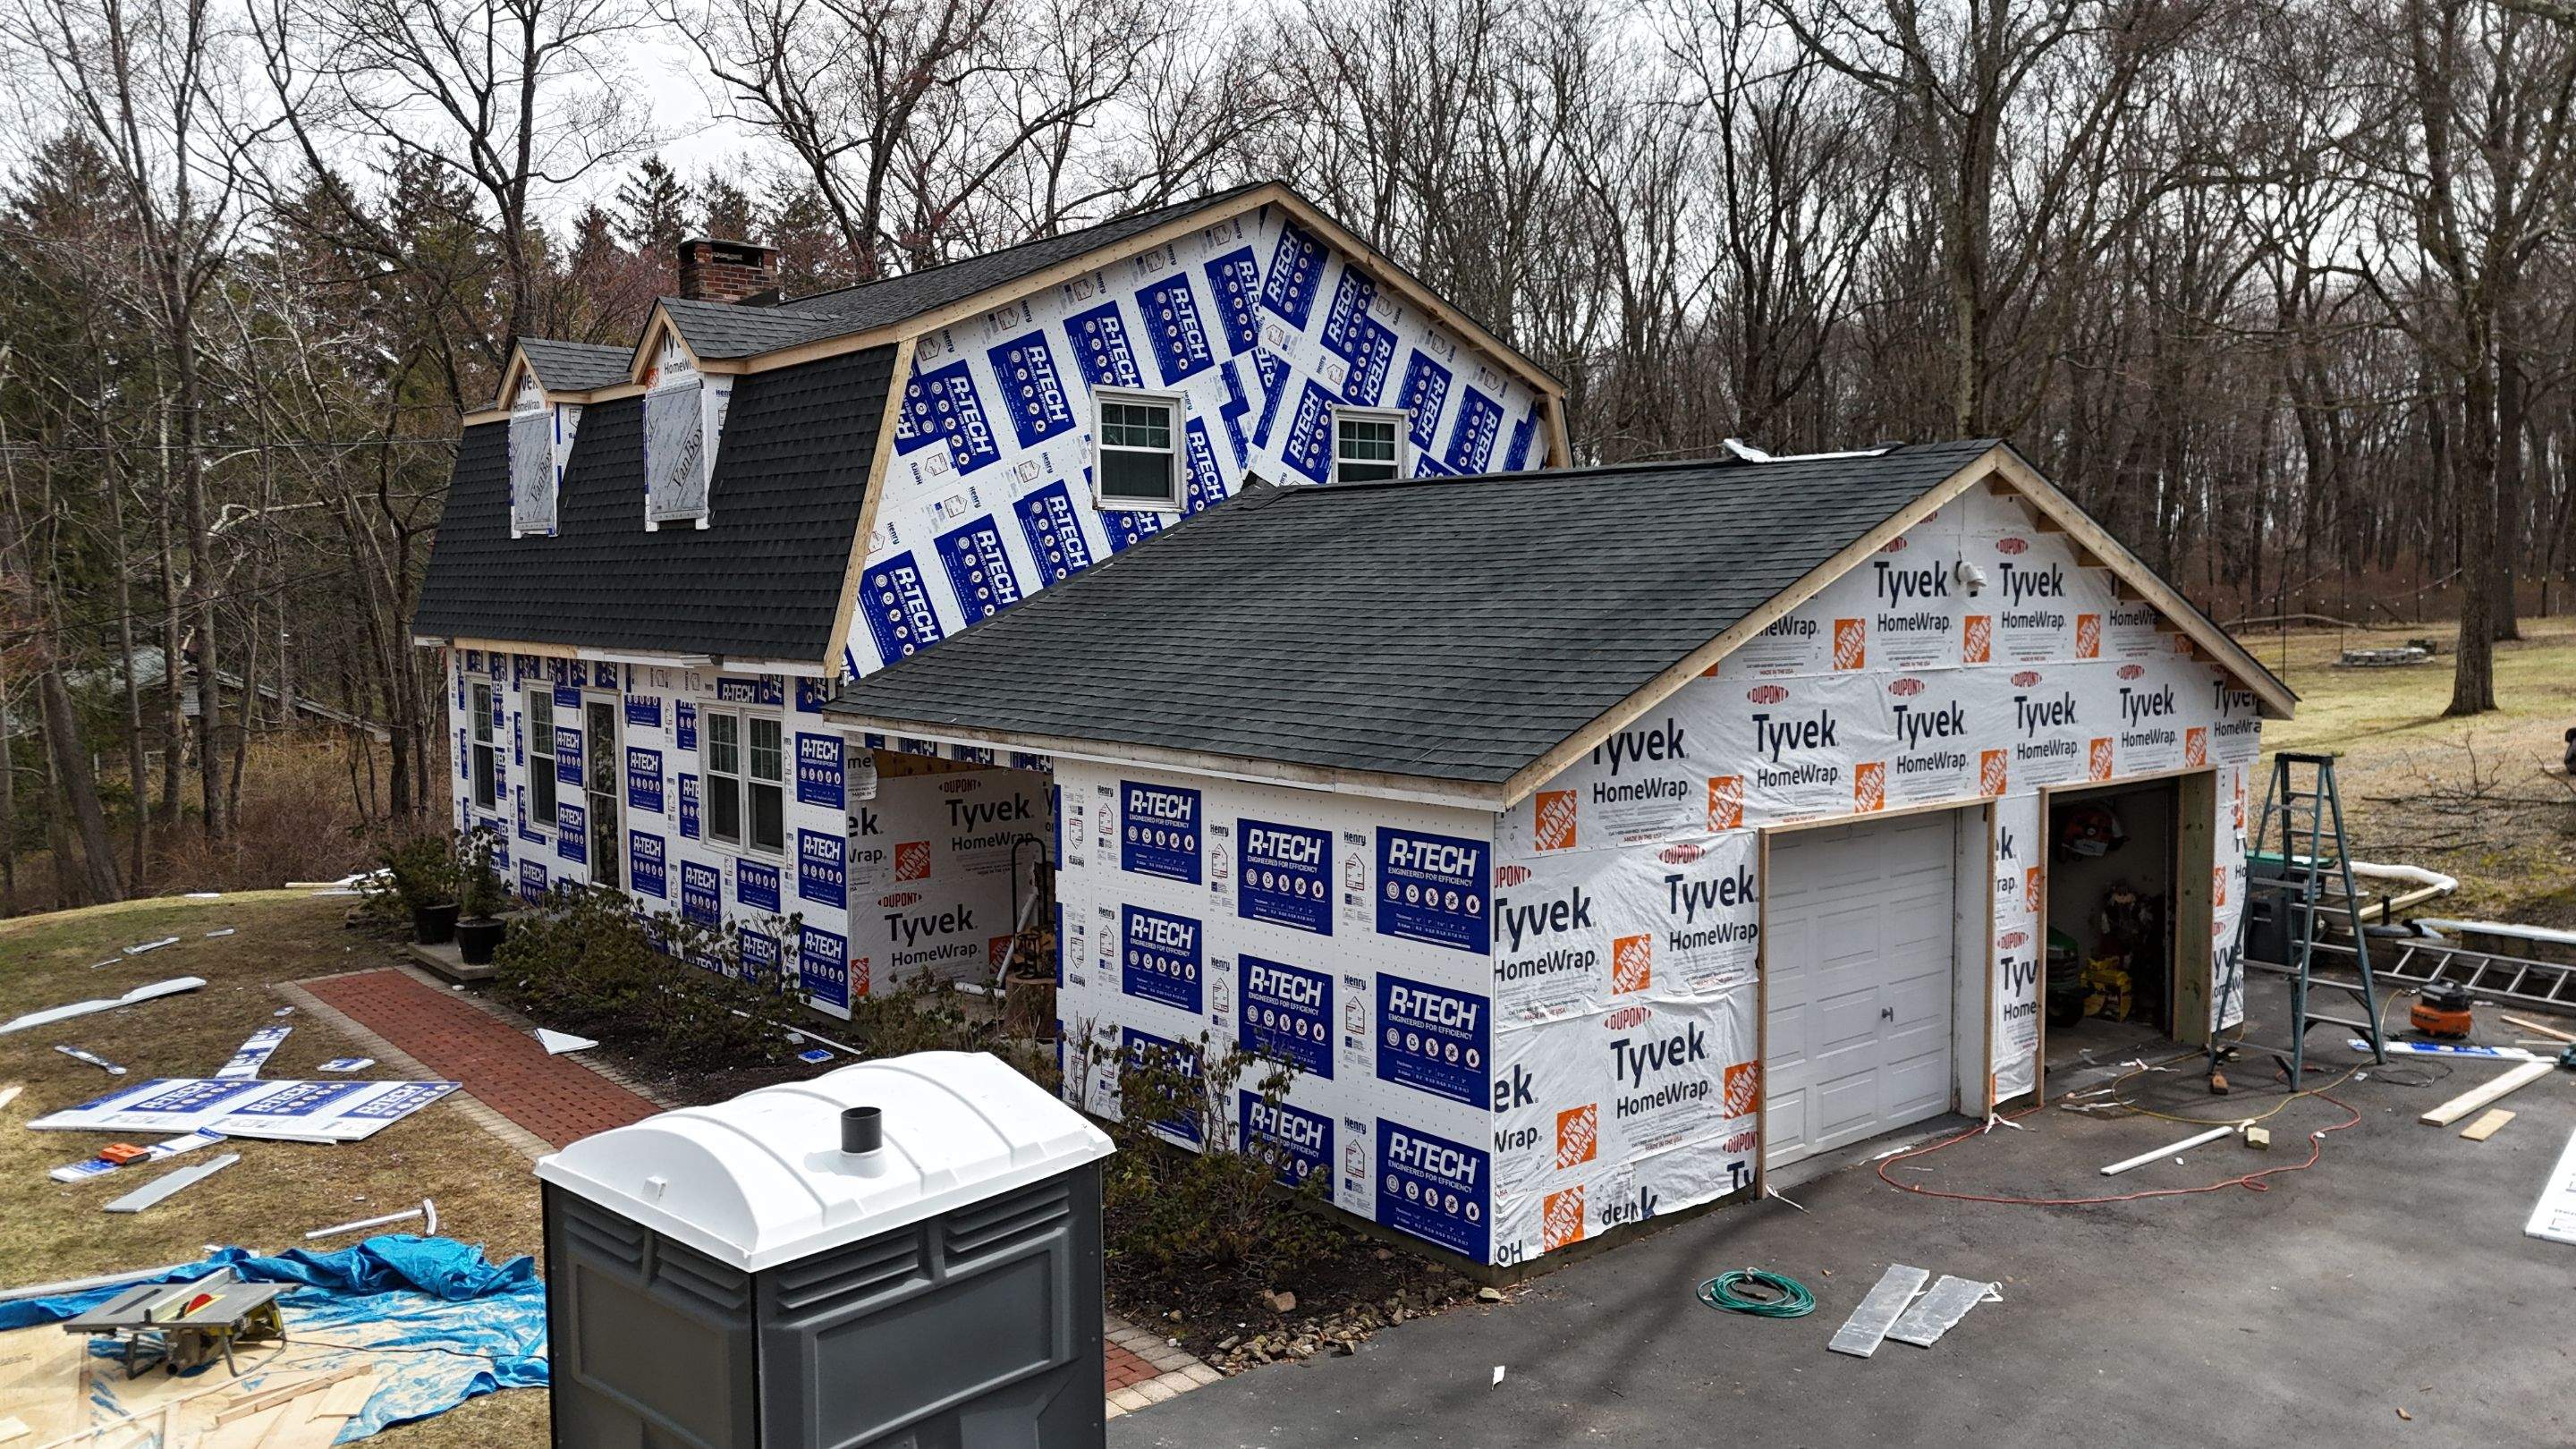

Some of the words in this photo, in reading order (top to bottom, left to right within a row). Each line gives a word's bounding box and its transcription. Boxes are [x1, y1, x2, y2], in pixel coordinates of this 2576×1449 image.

[1167, 244, 1177, 266] Henry
[1267, 231, 1298, 302] R-TECH
[1096, 272, 1106, 294] Henry
[1021, 301, 1032, 322] Henry
[1327, 272, 1357, 343] R-TECH
[1174, 288, 1208, 359] R-TECH
[942, 330, 955, 353] Henry
[1103, 317, 1140, 388] R-TECH
[1029, 346, 1068, 421] R-TECH
[1364, 338, 1391, 406] R-TECH
[951, 377, 992, 453] R-TECH
[1419, 375, 1445, 442] R-TECH
[1289, 386, 1319, 459] R-TECH
[672, 423, 703, 487] VanBox
[1473, 411, 1497, 474] R-TECH
[1041, 452, 1055, 474] Henry
[1042, 452, 1054, 474] Henry
[1189, 431, 1224, 501] R-TECH
[970, 486, 981, 508] Henry
[887, 521, 900, 545] Henry
[1050, 496, 1087, 568] R-TECH
[977, 530, 1019, 604] R-TECH
[1874, 561, 1948, 608] Tyvek
[2000, 563, 2063, 606] Tyvek
[895, 567, 939, 643] R-TECH
[2109, 610, 2158, 626] HomeWra
[1878, 612, 1949, 633] HomeWrap
[2002, 611, 2064, 631] HomeWrap
[1893, 678, 1921, 697] DUPONT
[2013, 672, 2040, 687] DUPONT
[723, 684, 755, 703] R-TECH
[1752, 685, 1786, 704] DUPONT
[2120, 683, 2174, 727] Tyvek
[1894, 700, 1964, 750] Tyvek
[2014, 691, 2076, 738] Tyvek
[2215, 717, 2262, 737] HomeWra
[557, 732, 579, 749] R-TECH
[1752, 709, 1835, 763] Tyvek
[2122, 728, 2175, 748] HomeWrap
[630, 752, 658, 772] R-TECH
[801, 739, 839, 761] R-TECH
[1897, 751, 1966, 774] HomeWrap
[2017, 740, 2078, 761] HomeWrap
[944, 779, 977, 792] DUPONT
[1758, 765, 1838, 788] HomeWrap
[1097, 785, 1114, 798] Henry
[1593, 777, 1688, 804] HomeWrap
[560, 808, 581, 826] R-TECH
[945, 792, 1030, 833] Tyvek
[1131, 790, 1193, 820] R-TECH
[1540, 797, 1556, 821] THE
[1210, 824, 1229, 836] Henry
[1536, 790, 1577, 851] HOME
[1551, 811, 1577, 849] DEPOT
[633, 836, 662, 856] R-TECH
[803, 835, 841, 860] R-TECH
[952, 832, 1034, 852] HomeWrap
[1248, 829, 1321, 864] R-TECH
[1344, 832, 1366, 846] Henry
[895, 841, 930, 882] HOME
[1247, 855, 1277, 866] ENGINEERED
[1278, 860, 1288, 869] FOR
[1289, 862, 1318, 873] EFFICIENCY
[1388, 838, 1477, 877] R-TECH
[1665, 844, 1699, 864] DUPONT
[522, 864, 545, 884] R-TECH
[686, 868, 716, 889] R-TECH
[1388, 867, 1424, 879] ENGINEERED
[1425, 873, 1437, 881] FOR
[1438, 875, 1473, 886] EFFICIENCY
[883, 893, 918, 908] DUPONT
[1665, 865, 1754, 925] Tyvek
[885, 904, 974, 947] Tyvek
[1099, 907, 1115, 919] Henry
[1495, 886, 1591, 953] Tyvek
[1131, 914, 1193, 949] R-TECH
[1670, 923, 1758, 952] HomeWrap
[2001, 932, 2026, 950] DUPONT
[743, 935, 777, 960] R-TECH
[805, 931, 842, 960] R-TECH
[892, 943, 978, 967] HomeWrap
[1211, 957, 1230, 971] Henry
[1495, 950, 1595, 982] HomeWrap
[1614, 934, 1650, 995] HOME
[2001, 957, 2038, 997] Tyv
[1249, 965, 1322, 1006] R-TECH
[1344, 975, 1366, 990] Henry
[1249, 992, 1279, 1005] ENGINEERED
[1279, 1000, 1290, 1009] FOR
[1291, 1003, 1319, 1016] EFFICIENCY
[1388, 985, 1477, 1030] R-TECH
[1388, 1013, 1424, 1029] ENGINEERED
[1425, 1023, 1437, 1032] FOR
[1438, 1026, 1473, 1041] EFFICIENCY
[1610, 1007, 1646, 1030] DUPONT
[1610, 1021, 1706, 1089] Tyvek
[141, 1081, 214, 1109] R-TECH
[1724, 1061, 1758, 1120] HOME
[1729, 1072, 1744, 1094] THE
[247, 1084, 318, 1113] R-TECH
[358, 1084, 424, 1114] R-TECH
[1617, 1080, 1708, 1119] HomeWrap
[1345, 1116, 1366, 1134] Henry
[1557, 1104, 1597, 1167] HOME
[1561, 1115, 1578, 1140] THE
[1389, 1131, 1477, 1184] R-TECH
[1572, 1124, 1597, 1165] DEPOT
[1388, 1159, 1424, 1178] ENGINEERED
[1425, 1172, 1437, 1182] FOR
[1438, 1176, 1473, 1194] EFFICIENCY
